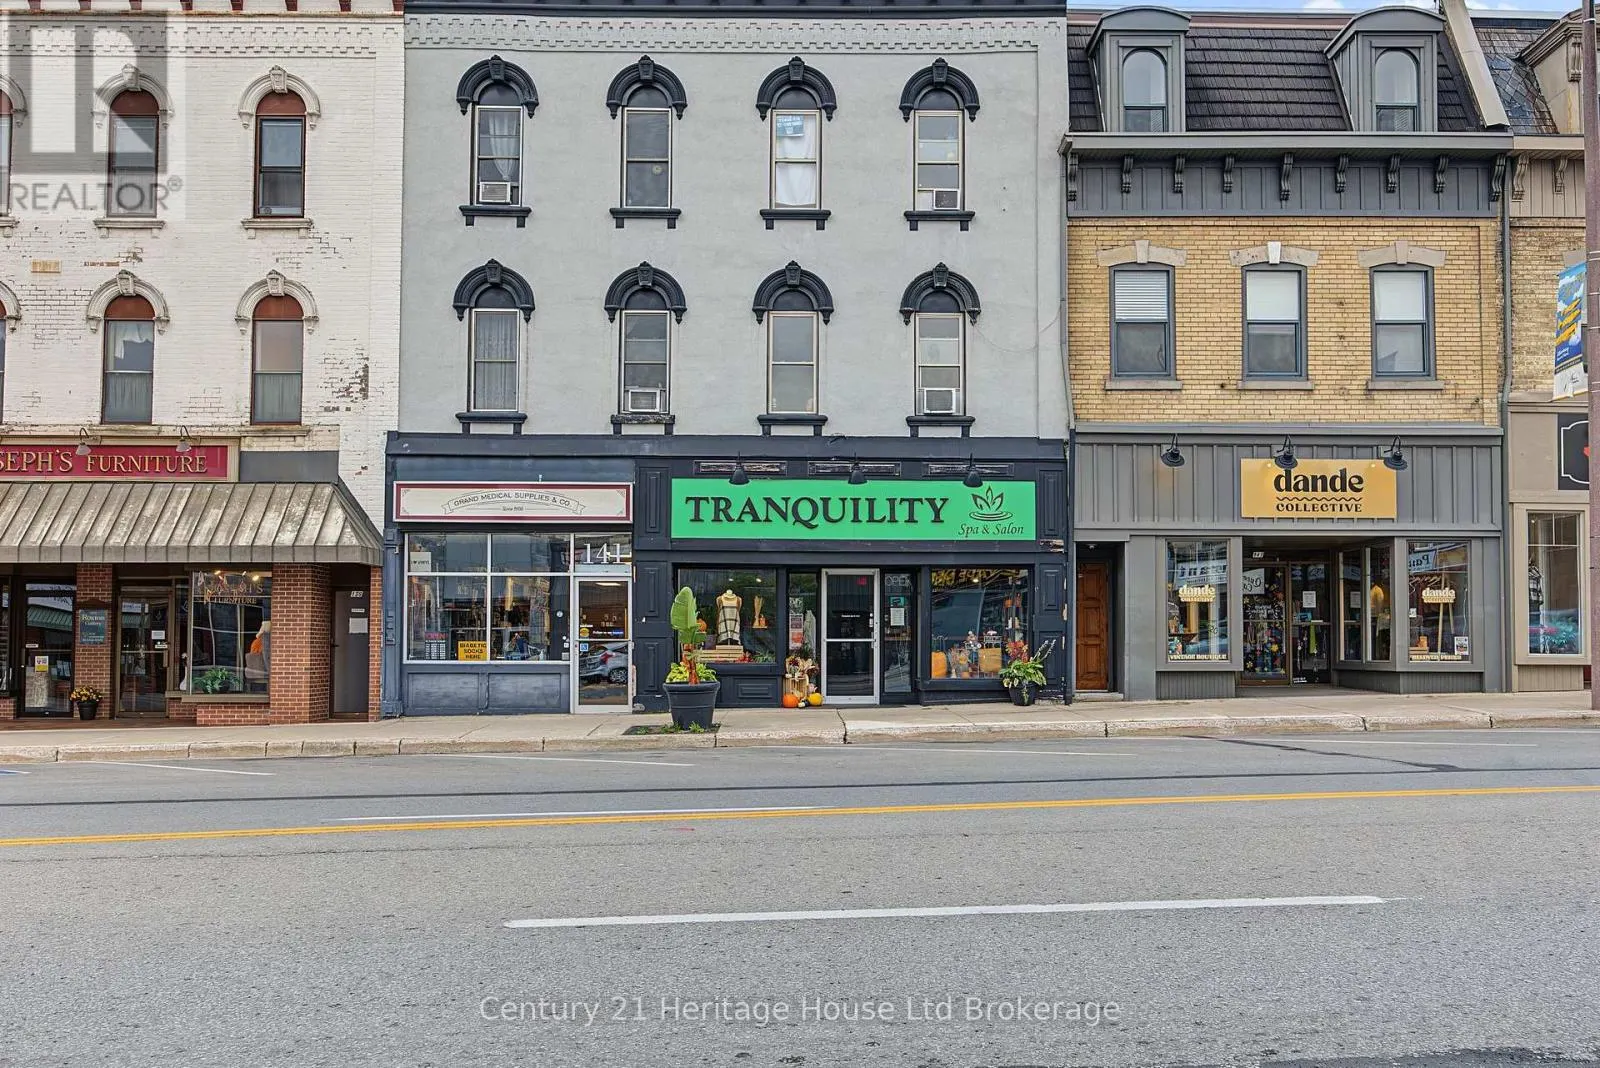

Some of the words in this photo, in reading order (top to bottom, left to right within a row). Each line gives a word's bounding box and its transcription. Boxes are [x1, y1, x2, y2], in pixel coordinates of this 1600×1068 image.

[86, 455, 208, 473] FURNITURE
[1274, 467, 1364, 492] dande
[454, 496, 479, 507] GRAND
[481, 492, 512, 501] MEDICAL
[514, 492, 550, 502] SUPPLIES
[1276, 502, 1362, 512] COLLECTIVE
[685, 496, 949, 529] TRANQUILITY
[958, 522, 980, 536] Spa
[982, 524, 990, 535] &
[992, 522, 1025, 536] Salon
[583, 543, 621, 564] 141
[1178, 584, 1216, 597] dande
[1421, 587, 1456, 599] dande
